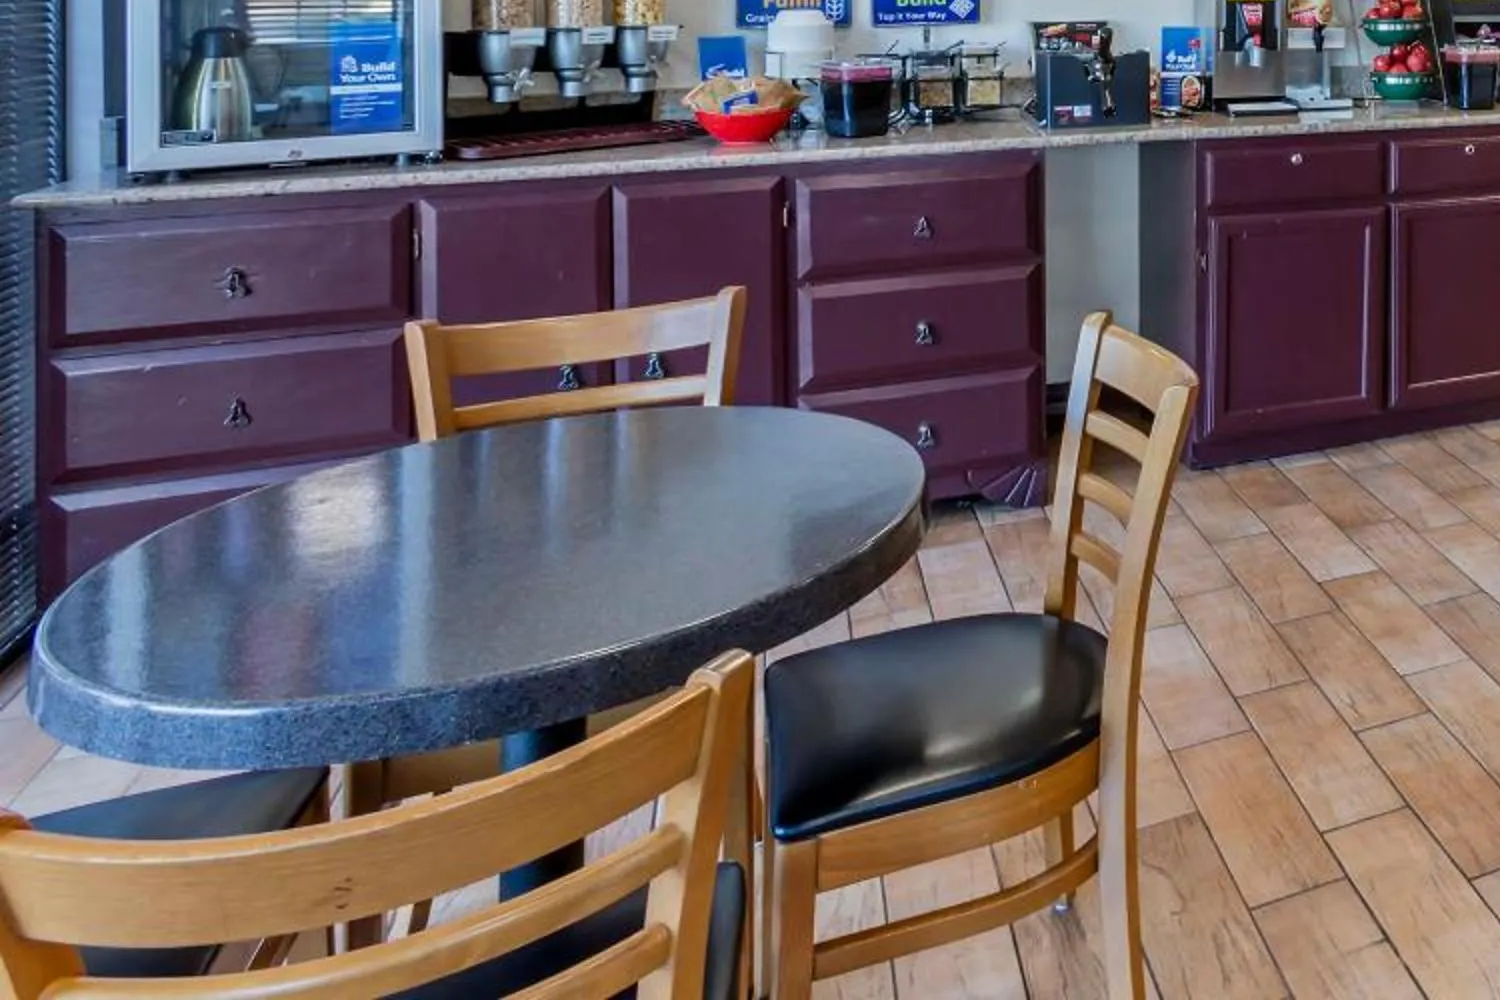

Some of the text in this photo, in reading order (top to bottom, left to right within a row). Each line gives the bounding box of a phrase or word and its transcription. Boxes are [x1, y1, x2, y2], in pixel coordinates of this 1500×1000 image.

[927, 11, 947, 22] Way
[361, 62, 397, 73] Build
[340, 72, 398, 84] Your Own
